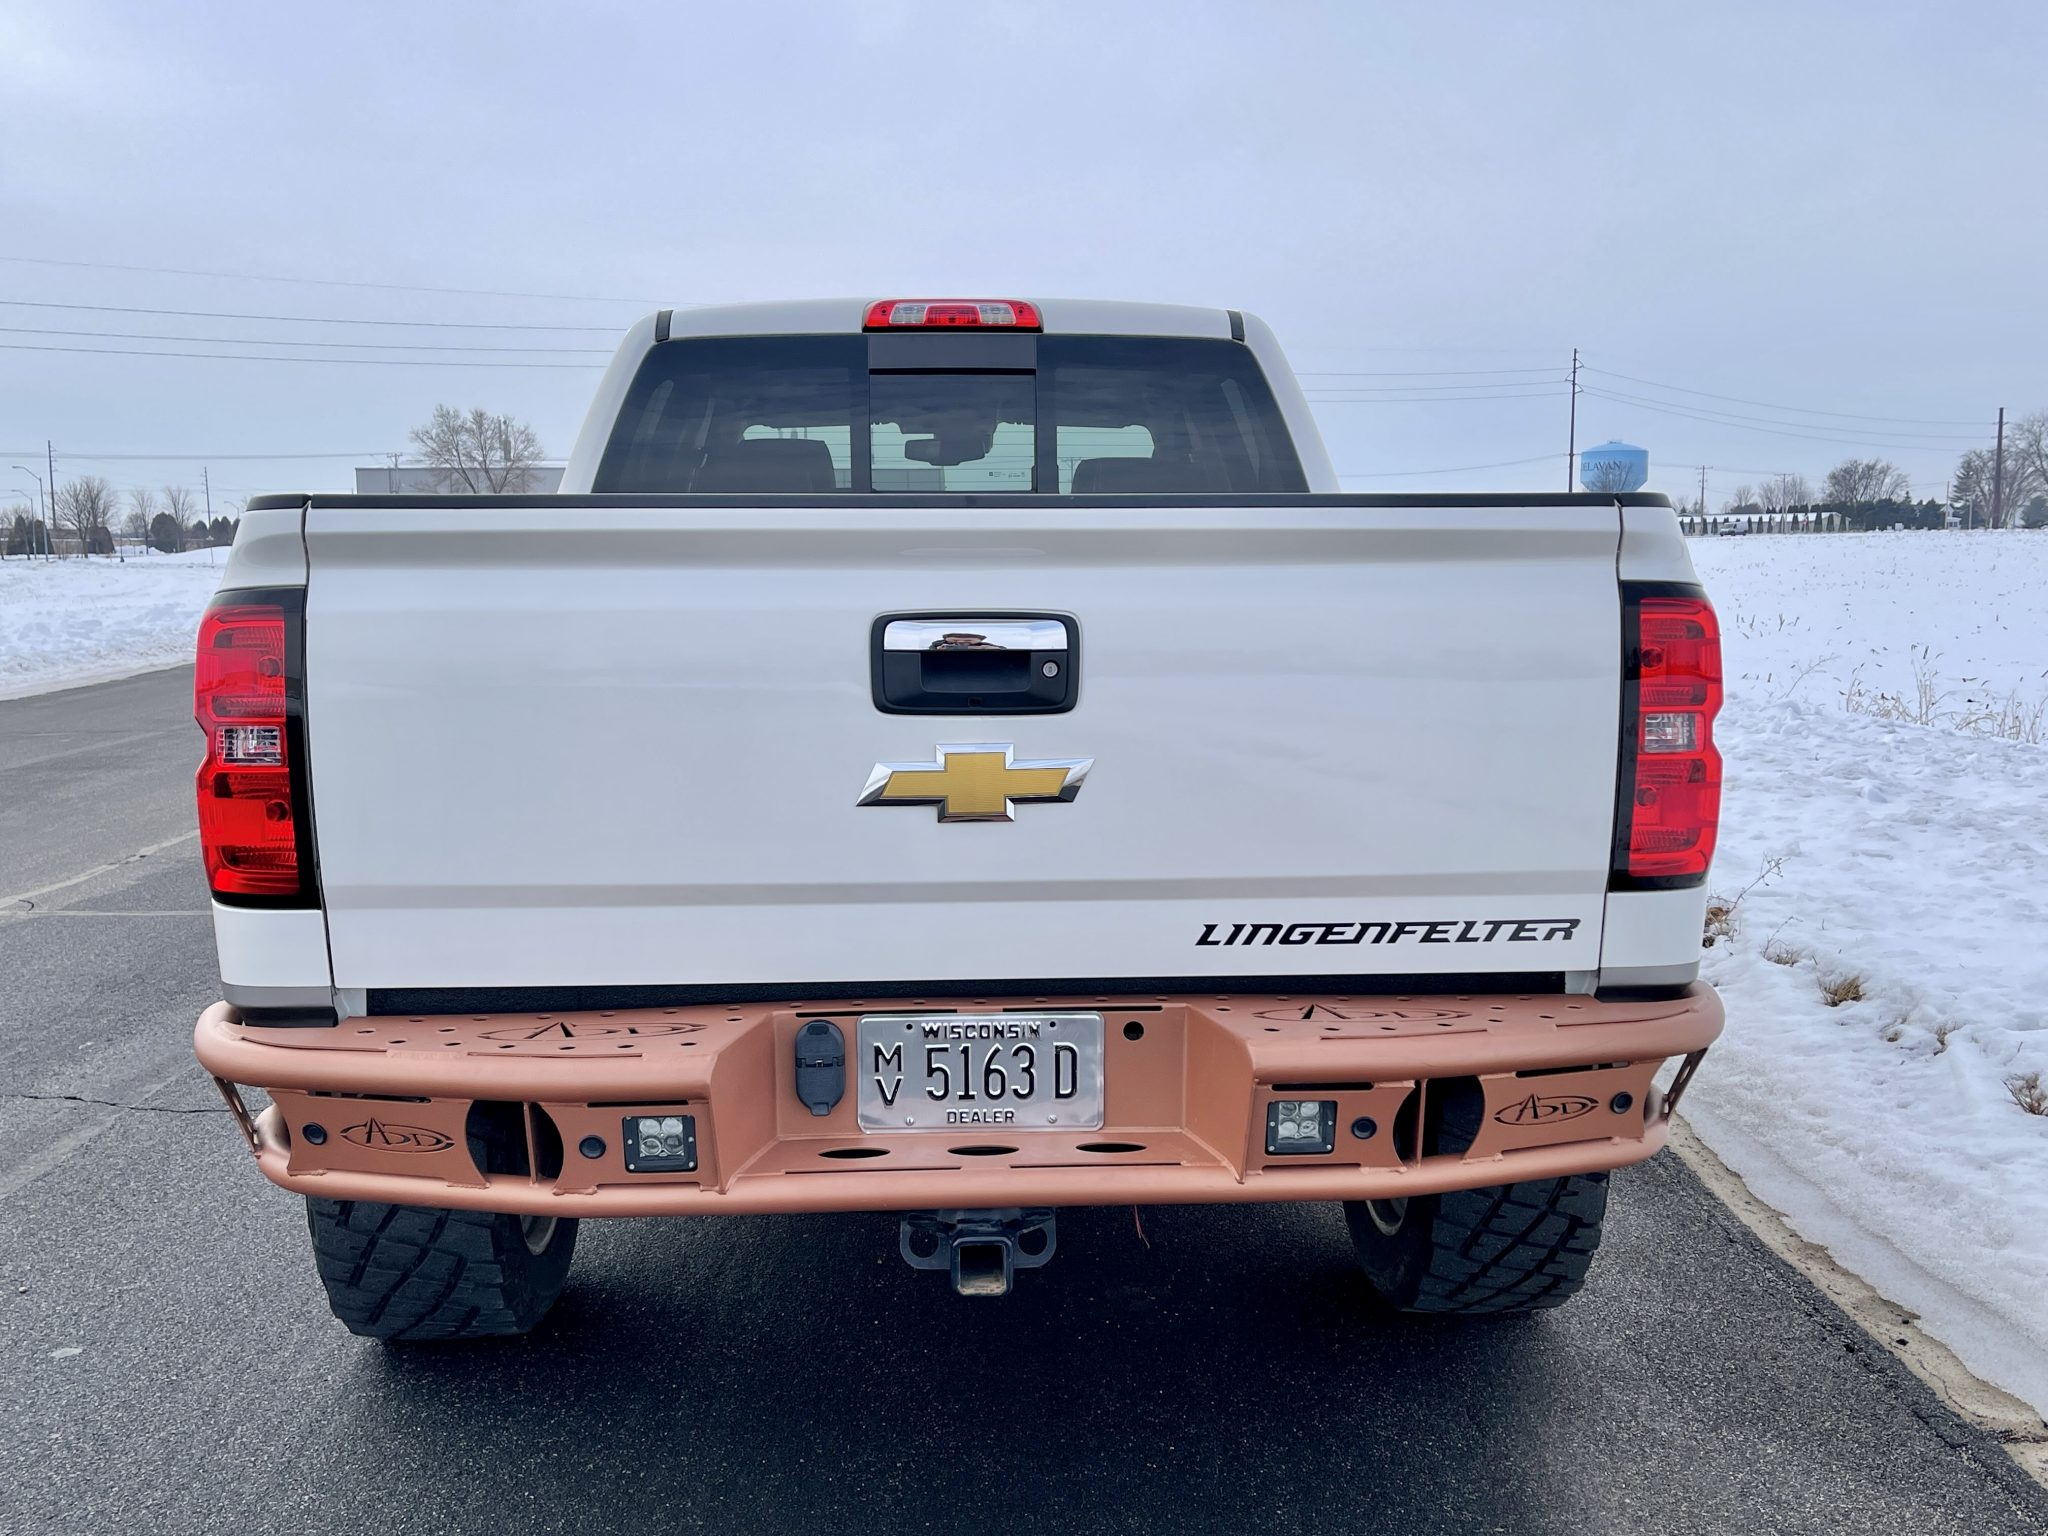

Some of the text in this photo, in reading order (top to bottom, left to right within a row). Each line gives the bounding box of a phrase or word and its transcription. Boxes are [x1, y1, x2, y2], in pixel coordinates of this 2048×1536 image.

[1581, 461, 1622, 471] ELAVAN
[1195, 918, 1581, 946] LINGENFELTER
[921, 1022, 1041, 1041] WISCONSIN
[924, 1043, 1036, 1101] 5163
[946, 1108, 1016, 1124] DEALER
